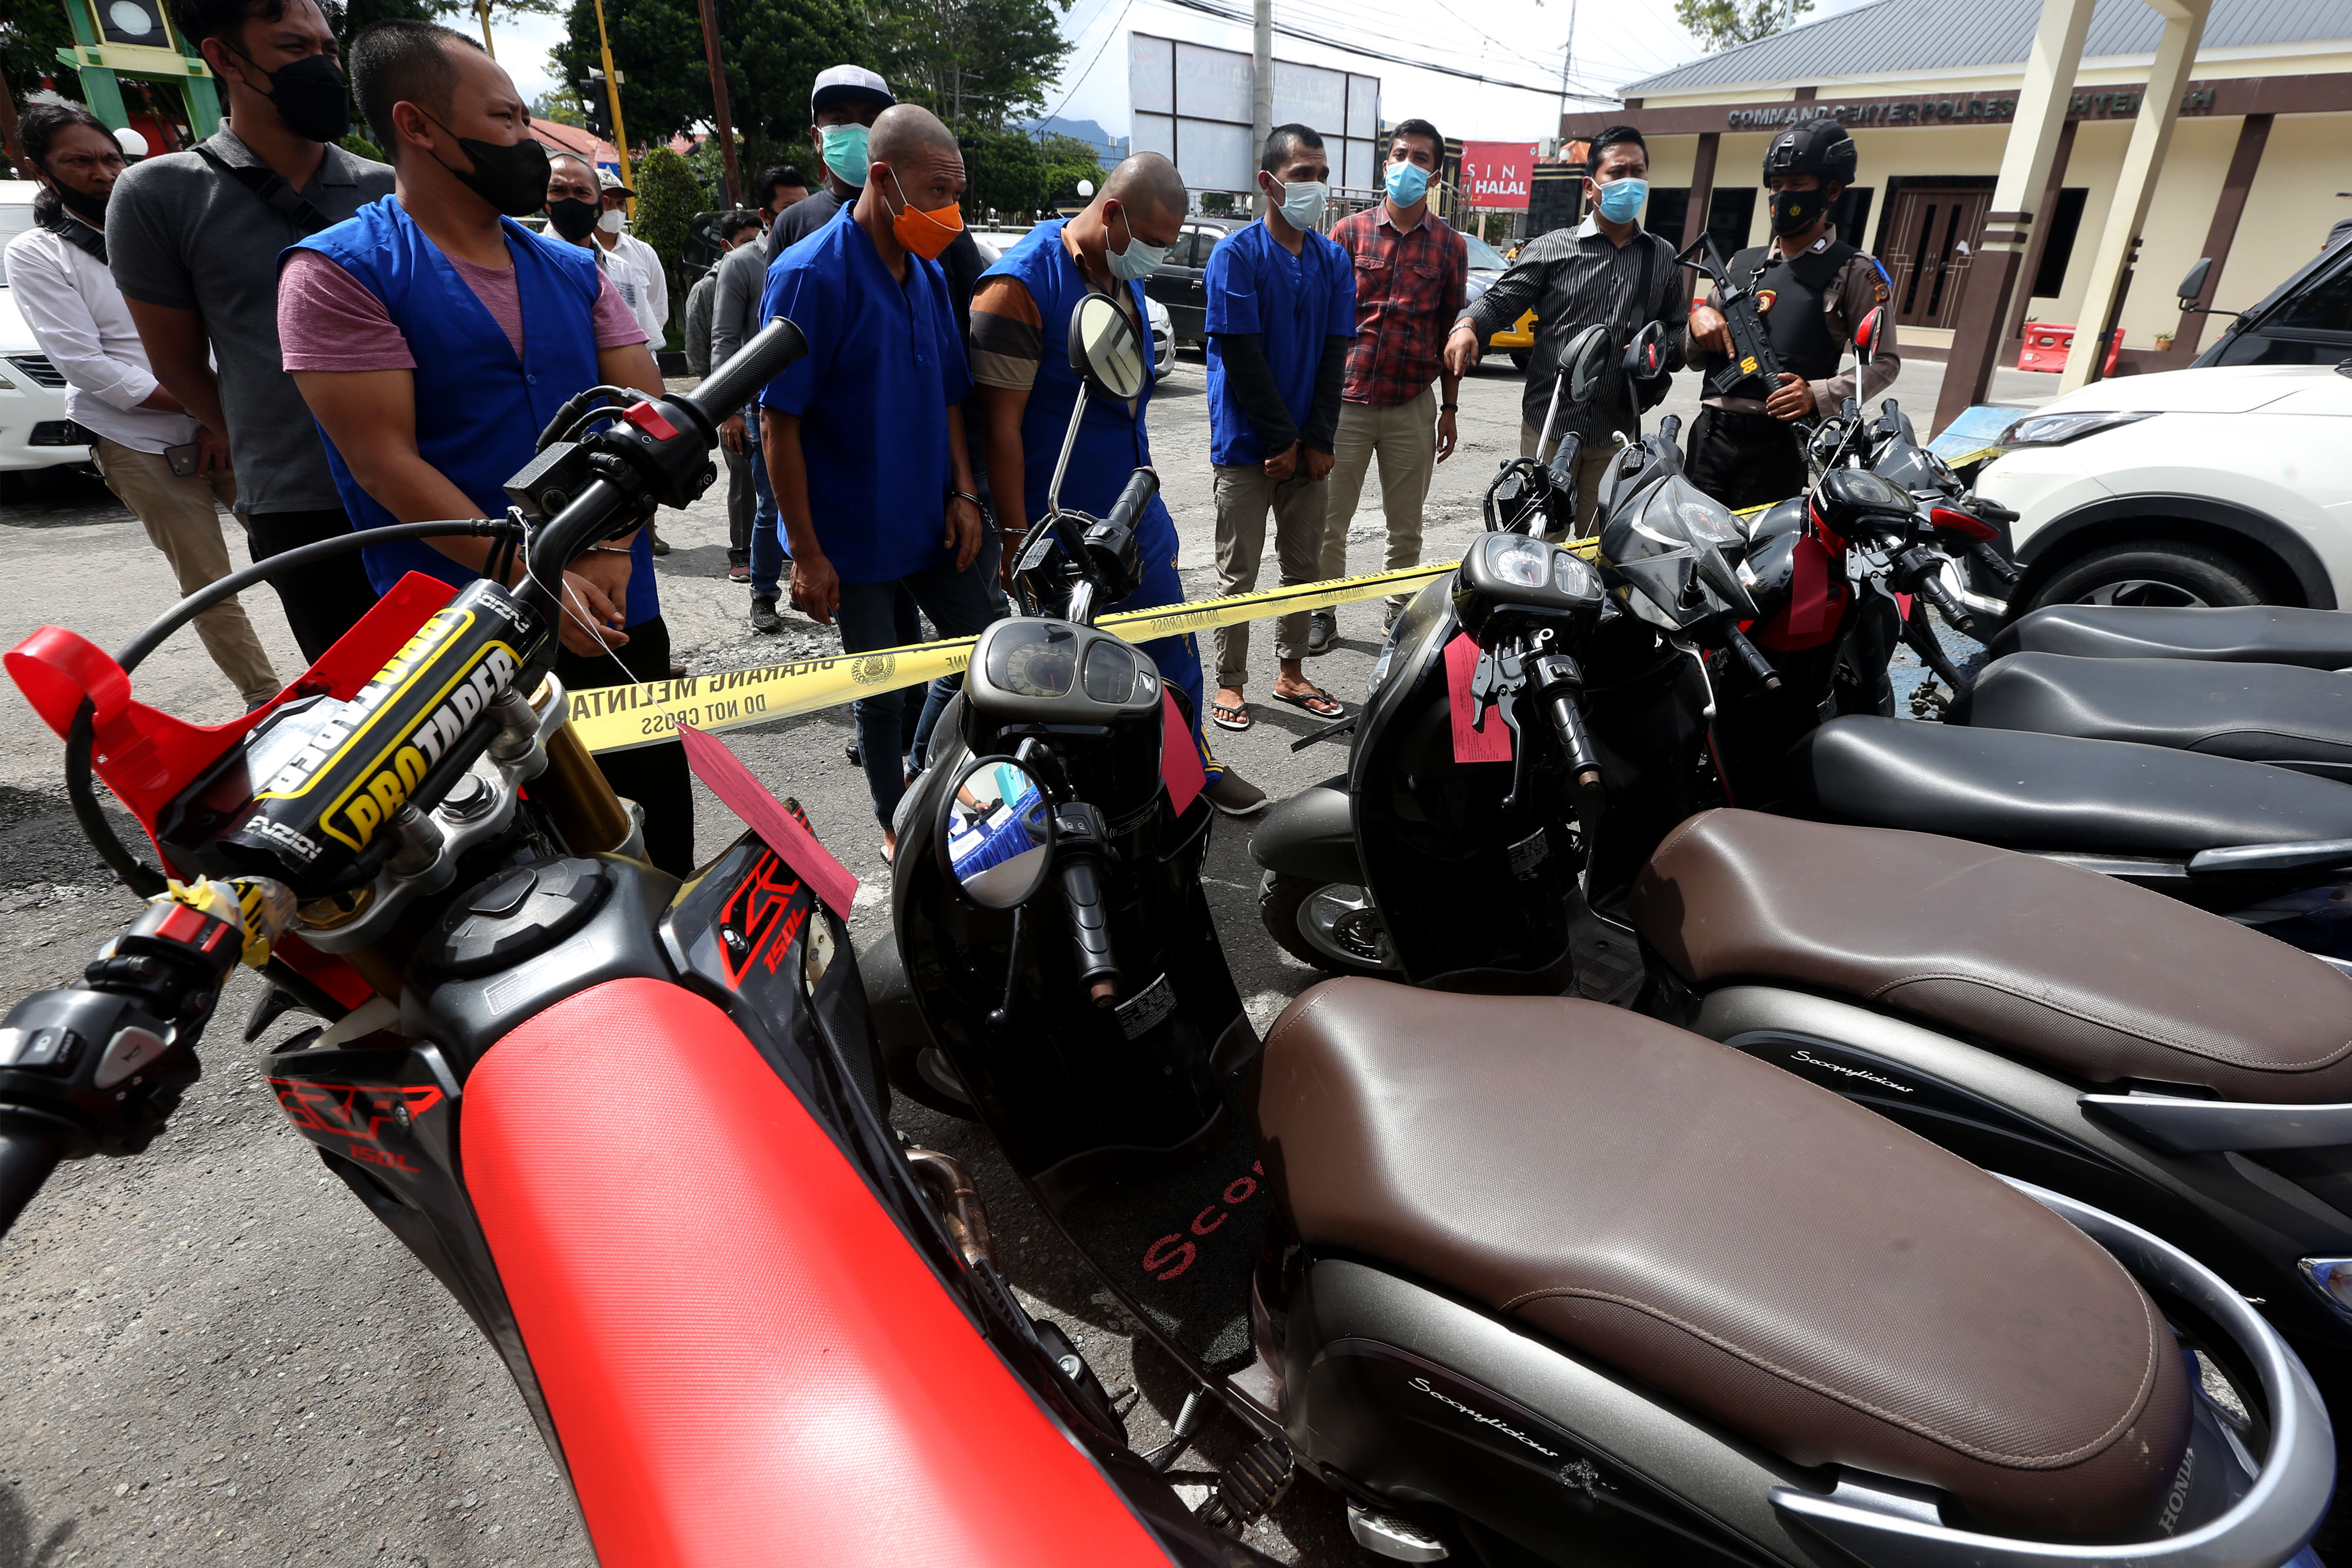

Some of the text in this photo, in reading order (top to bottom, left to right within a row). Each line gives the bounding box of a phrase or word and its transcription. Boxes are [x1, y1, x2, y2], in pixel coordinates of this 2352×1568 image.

[1728, 106, 1829, 125] COMMAND
[1832, 102, 1918, 122] CENTER
[1920, 97, 2015, 119] POLRES
[2095, 88, 2216, 112] TENH
[1475, 180, 1527, 195] HALAL
[1740, 356, 1759, 375] 08
[1816, 486, 1829, 511] HONDA
[763, 907, 806, 975] 150L
[347, 1144, 421, 1174] 150L
[2158, 1447, 2193, 1534] HONDA
